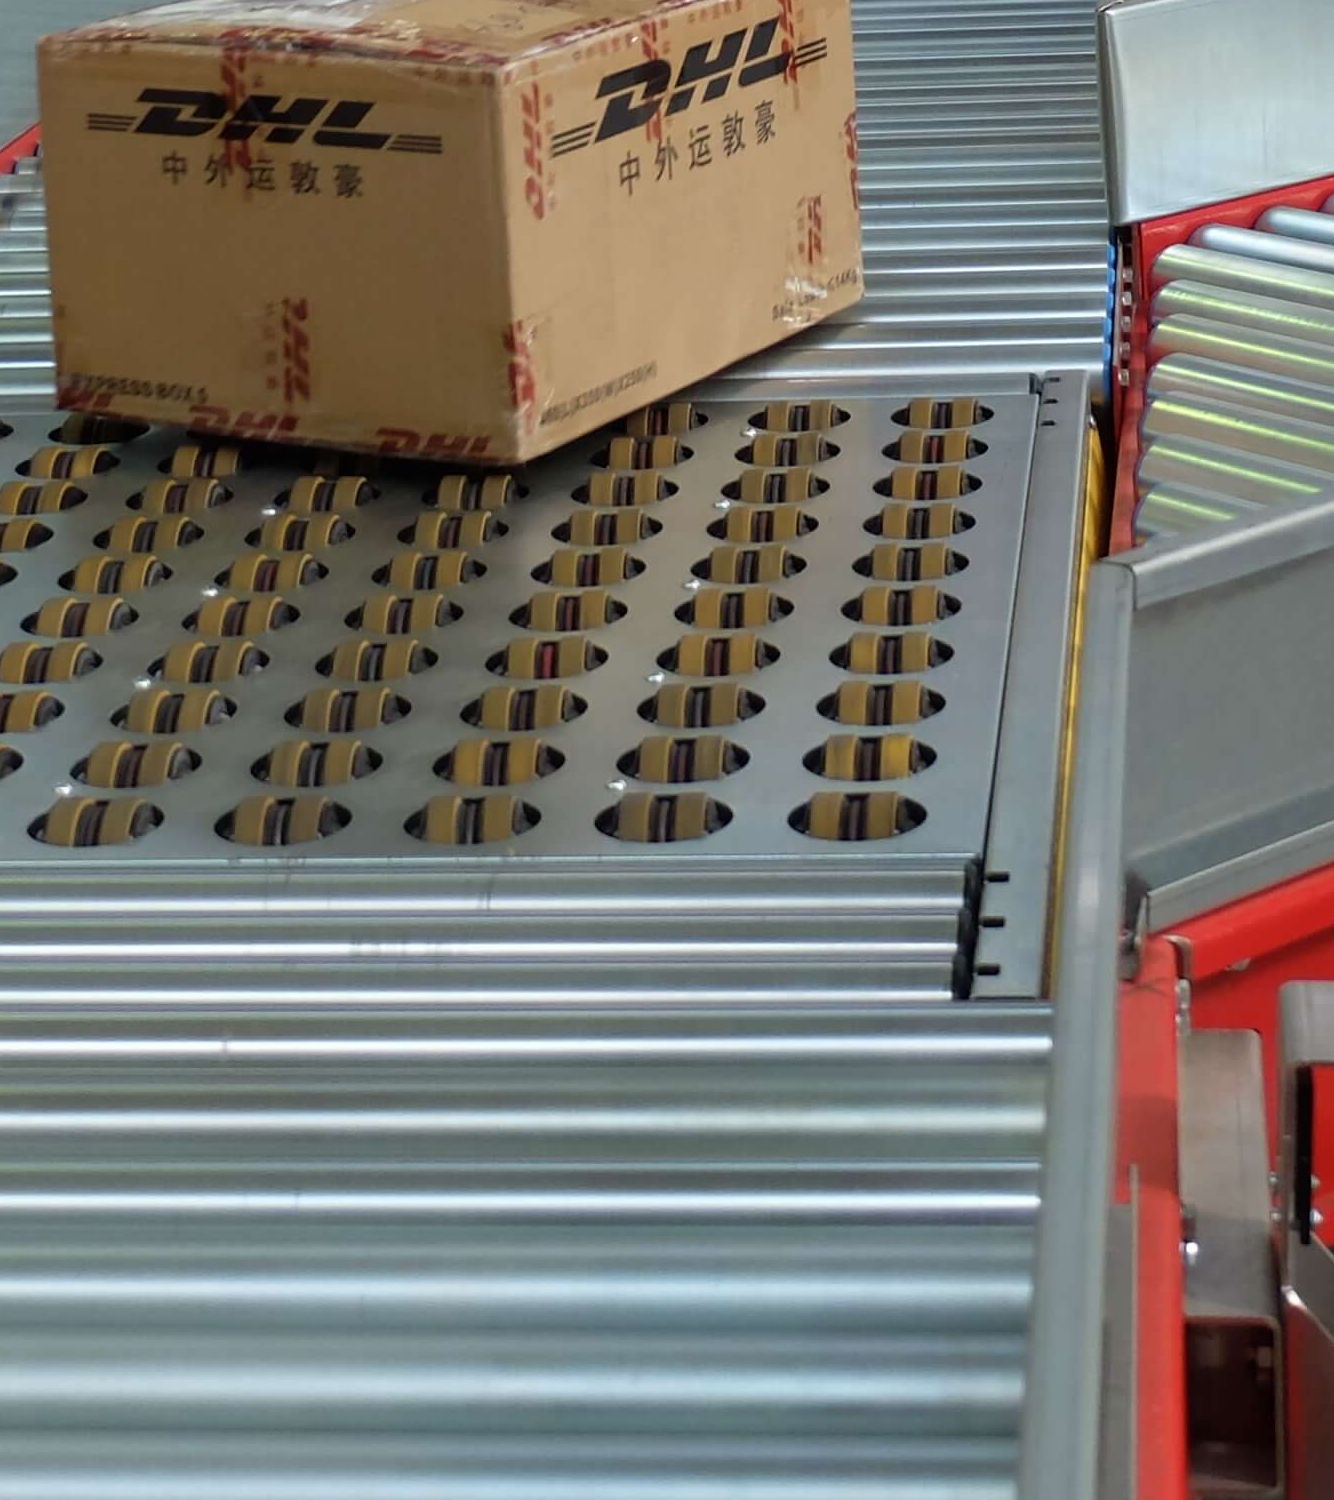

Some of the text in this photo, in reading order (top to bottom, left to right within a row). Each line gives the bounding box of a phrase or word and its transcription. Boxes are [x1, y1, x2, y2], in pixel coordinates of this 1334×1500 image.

[132, 88, 393, 150] DHL
[595, 15, 793, 144] DHL
[161, 150, 365, 199] 中外运敦豪
[619, 98, 779, 197] 中外运敦豪
